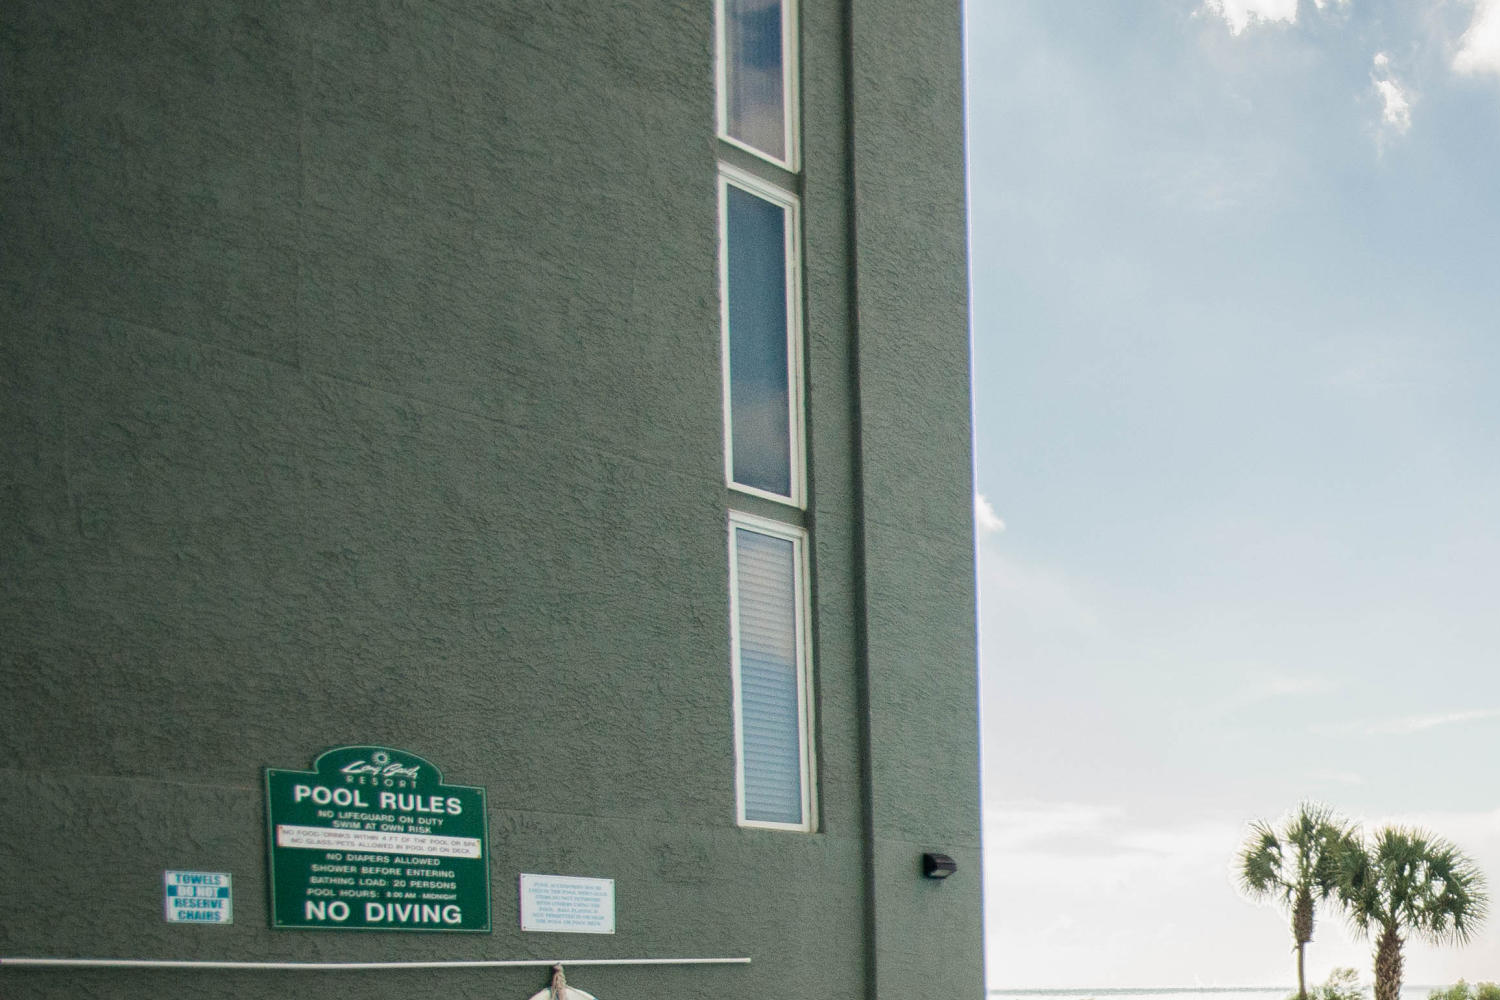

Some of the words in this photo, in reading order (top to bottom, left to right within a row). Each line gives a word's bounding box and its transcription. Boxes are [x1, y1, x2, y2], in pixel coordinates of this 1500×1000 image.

[345, 775, 417, 788] RESORT
[294, 784, 369, 807] POOL
[379, 791, 463, 815] RULES
[317, 810, 334, 818] NO
[338, 811, 395, 822] LIFEGUARD
[398, 815, 414, 824] ON
[418, 817, 444, 826] DUTY
[332, 820, 360, 829] SWIM
[364, 822, 377, 830] AT
[380, 823, 404, 832] OWN
[408, 825, 432, 834] RISK
[326, 852, 342, 861] NO
[346, 853, 390, 863] DIAPERS
[394, 856, 440, 866] ALLOWED
[311, 864, 357, 873] SHOWER
[361, 866, 402, 875] BEFORE
[406, 868, 455, 878] ENTERING
[175, 873, 221, 885] TOWELS
[310, 876, 355, 885] BATHING
[393, 880, 406, 888] 20
[410, 880, 457, 889] PERSONS
[306, 888, 336, 896] POOL
[339, 889, 380, 898] HOURS:
[174, 898, 223, 909] RESERVE
[178, 910, 221, 921] CHAIRS
[304, 900, 350, 921] NO
[365, 902, 463, 924] DIVING
